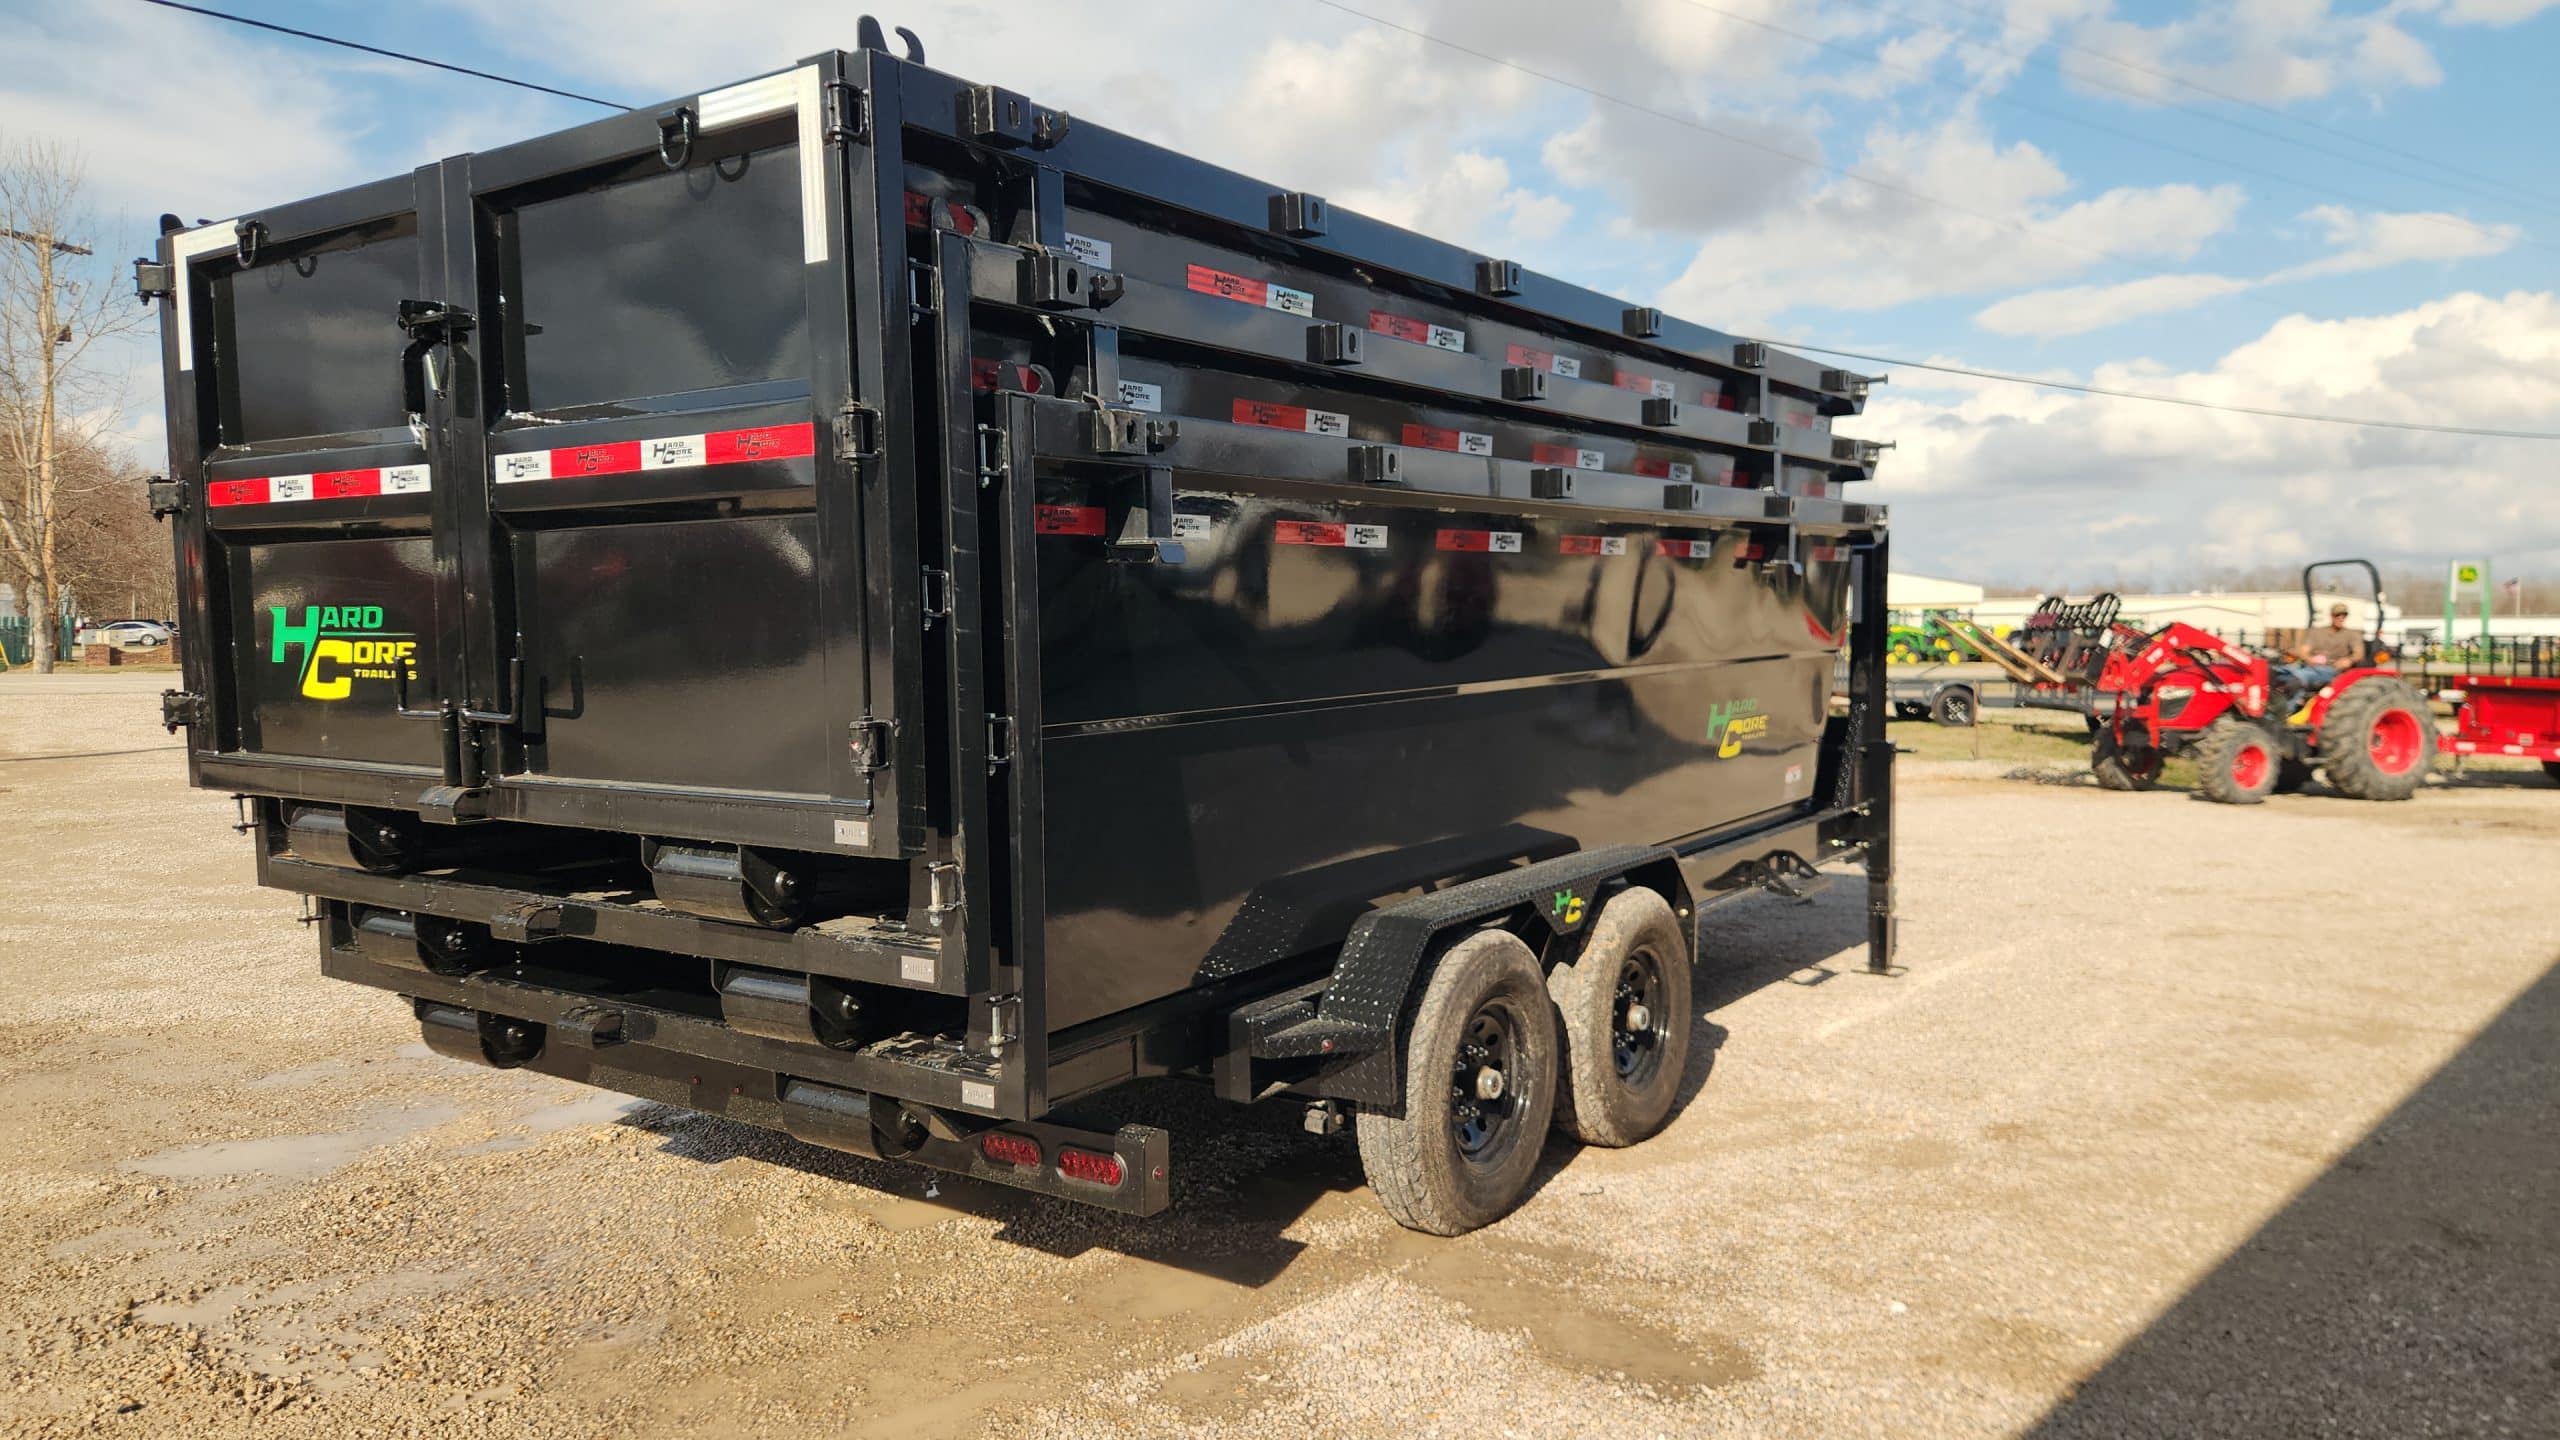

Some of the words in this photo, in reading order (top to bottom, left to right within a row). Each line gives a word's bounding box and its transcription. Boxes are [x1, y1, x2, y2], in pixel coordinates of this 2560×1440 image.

[270, 605, 384, 684] HARD
[302, 639, 417, 700] CORE
[353, 668, 418, 681] TRAILS
[1707, 698, 1758, 740] HARD
[1718, 714, 1769, 759] CORE
